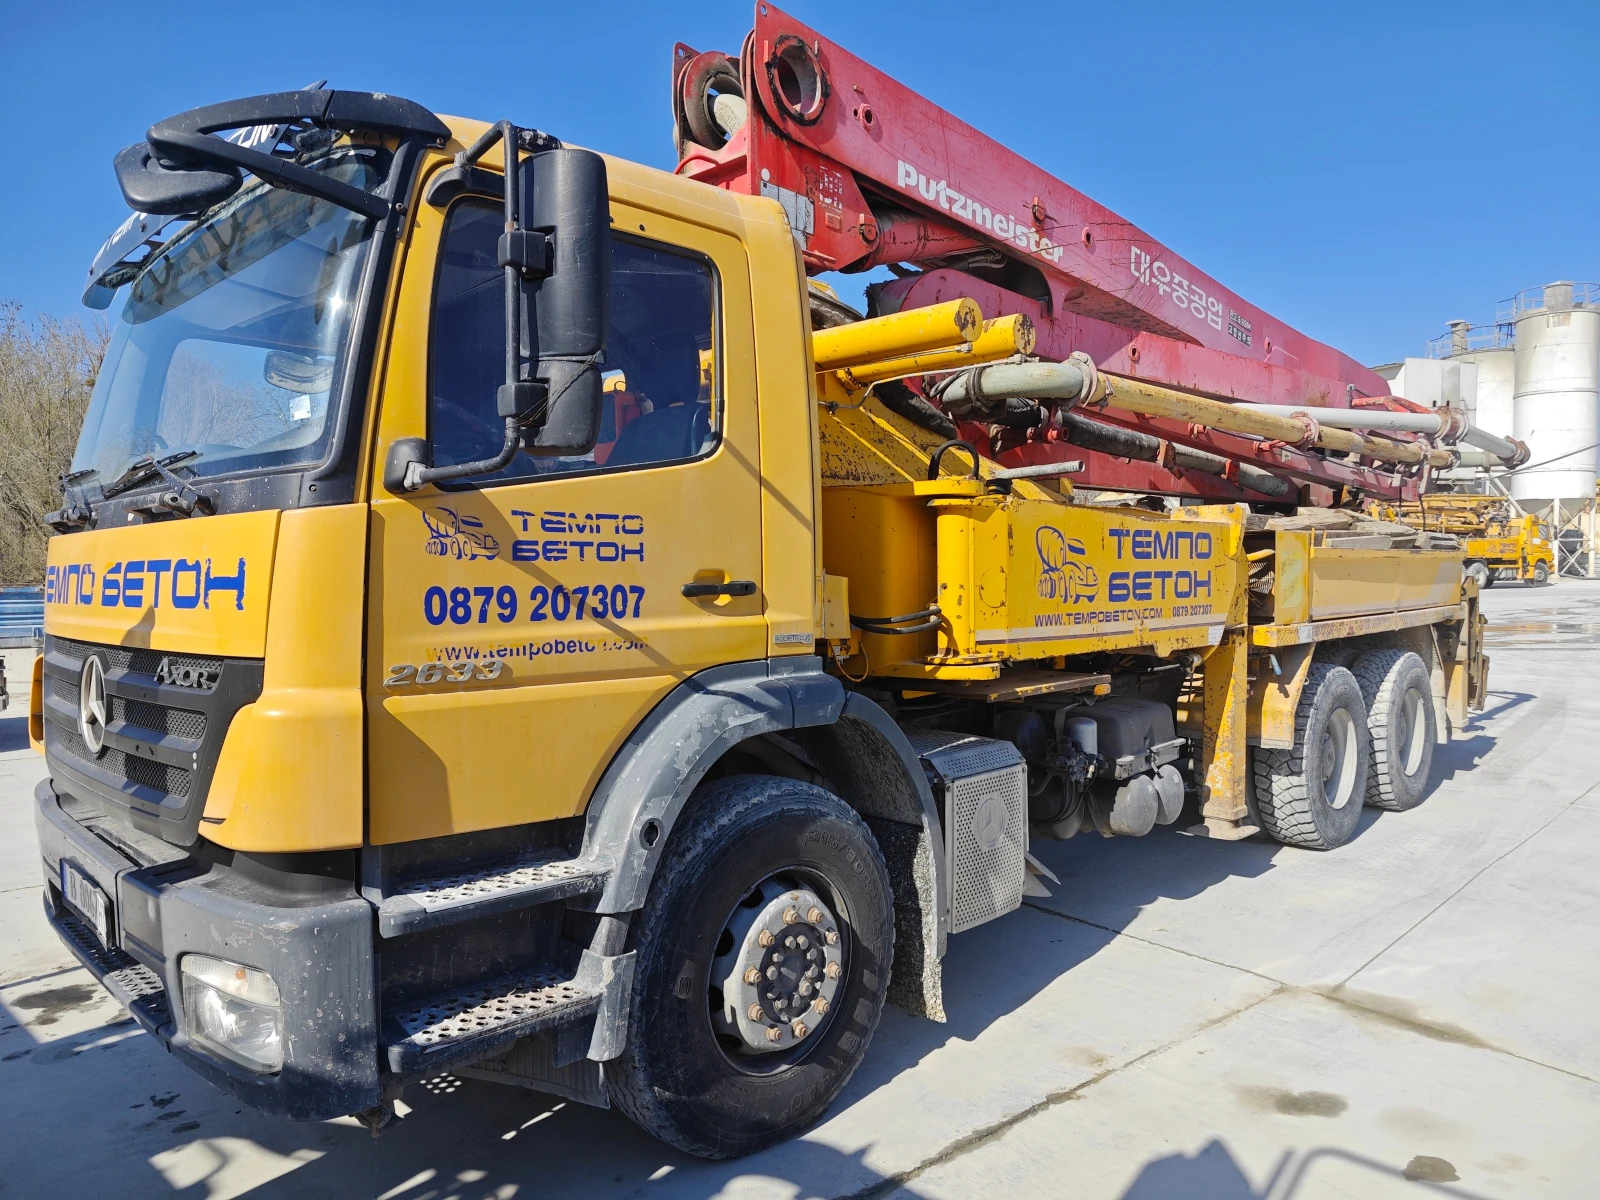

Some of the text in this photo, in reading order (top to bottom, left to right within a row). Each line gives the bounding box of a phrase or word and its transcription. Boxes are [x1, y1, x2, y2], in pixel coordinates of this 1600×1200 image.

[897, 160, 1064, 263] Putzmeister
[1130, 245, 1223, 331] 대우중공업
[510, 509, 645, 535] ТЕМПО
[512, 540, 645, 562] БЕТОН
[1108, 528, 1212, 560] ТЕМПО
[46, 557, 246, 611] ЕМПО БЕТОН
[1108, 570, 1212, 603] БЕТОН
[424, 583, 646, 625] 0879 207307
[1034, 604, 1213, 628] WWW.TEMPOBETON.COM 0879 207307
[382, 660, 504, 687] 2633
